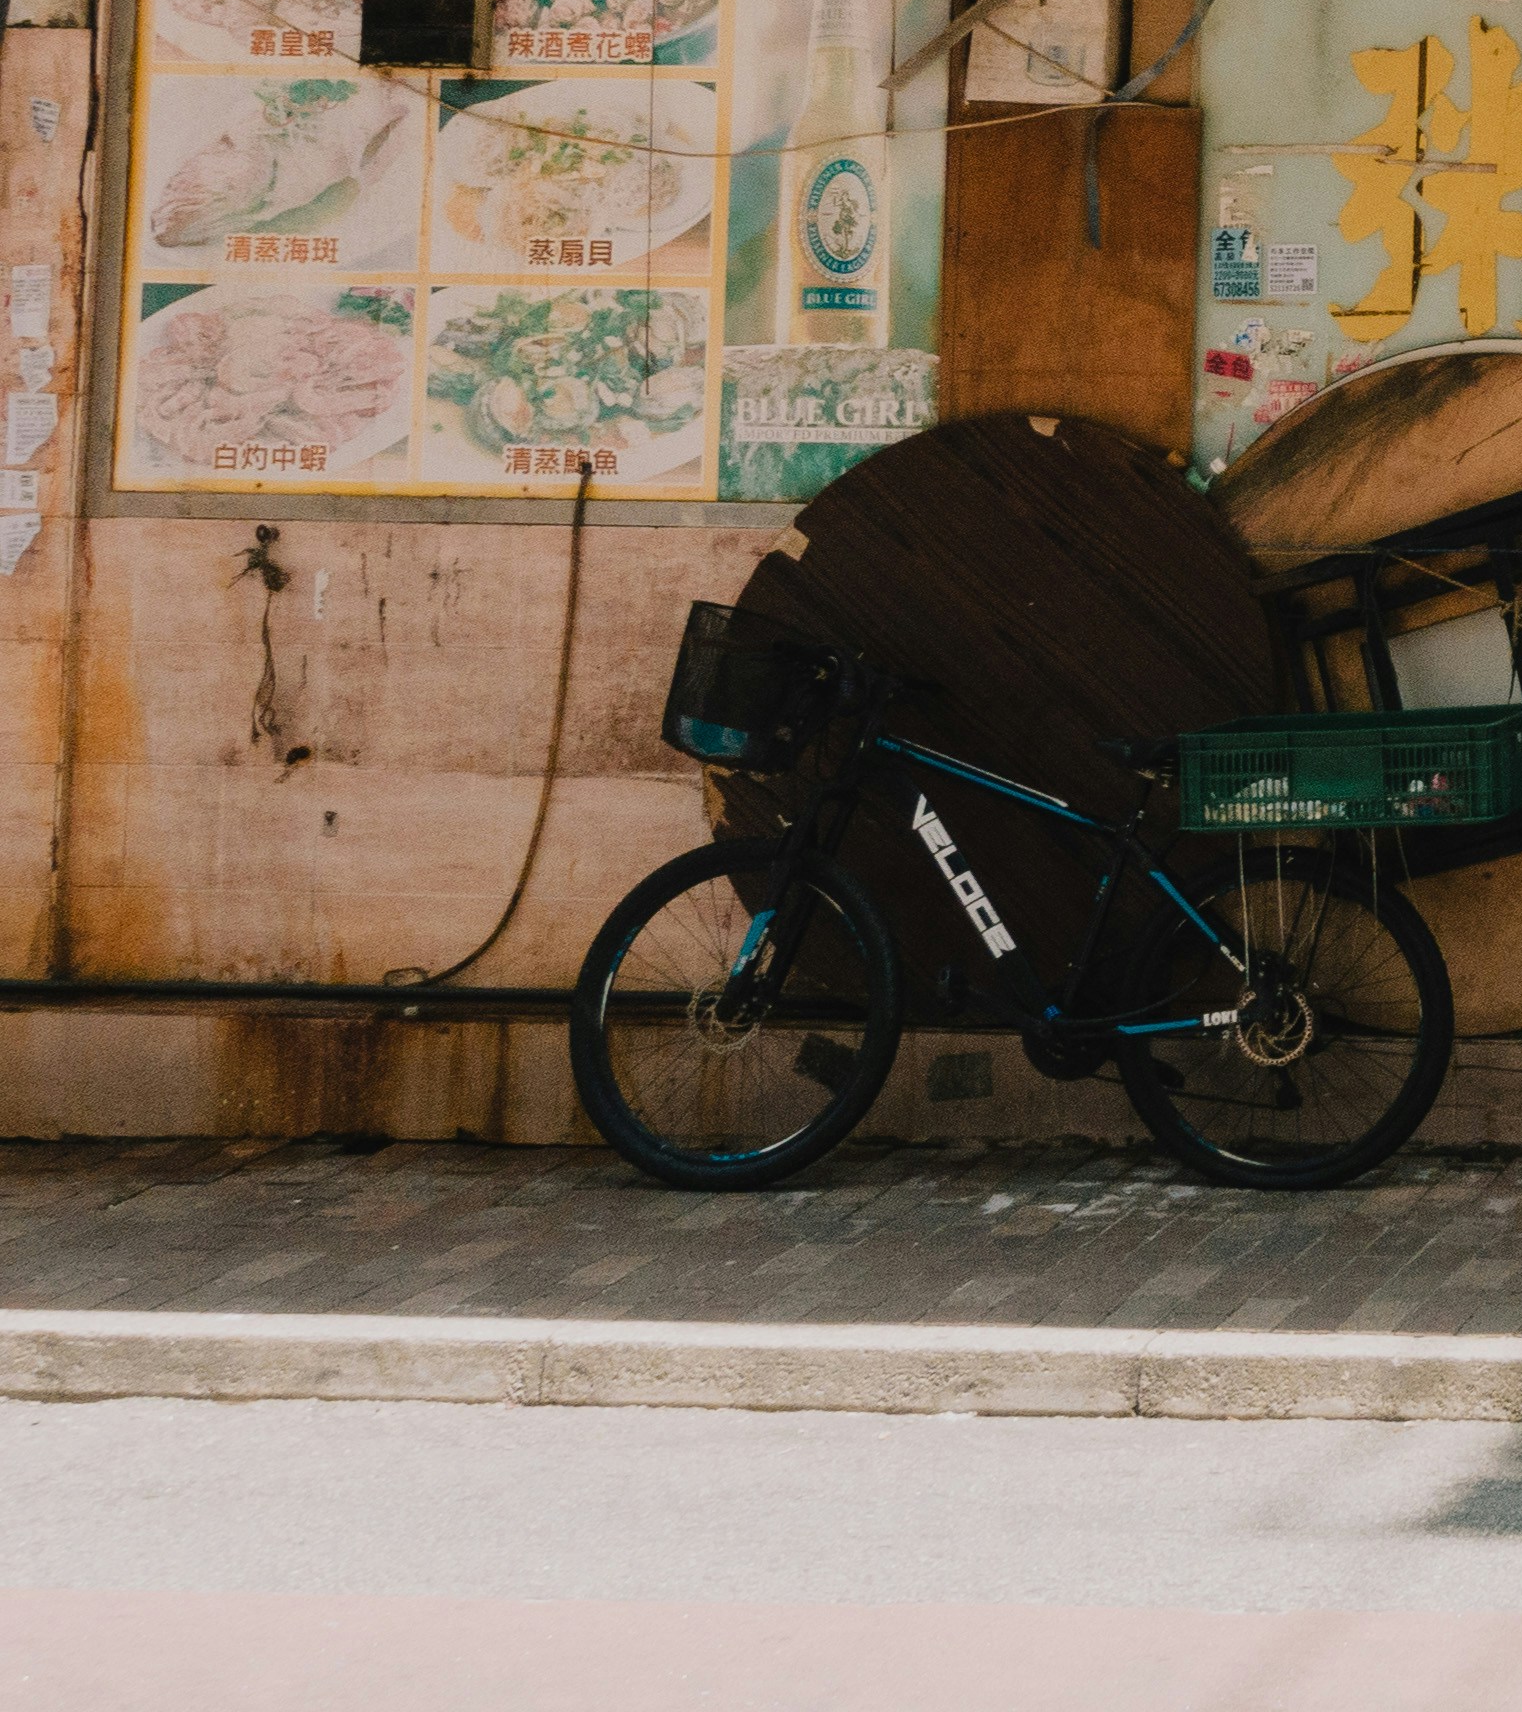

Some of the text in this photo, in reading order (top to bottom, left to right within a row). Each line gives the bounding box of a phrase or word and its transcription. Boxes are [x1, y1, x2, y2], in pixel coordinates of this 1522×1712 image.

[250, 29, 335, 58] 霸皇蝦
[507, 29, 653, 61] 辣酒煮花螺
[224, 234, 340, 264] 清蒸海斑
[527, 239, 614, 266] 蒸扇貝
[737, 398, 924, 426] BLUE GIRL
[213, 444, 328, 472] 白灼中蝦
[505, 447, 619, 476] 清蒸鮑魚
[911, 793, 1017, 959] VELOCE
